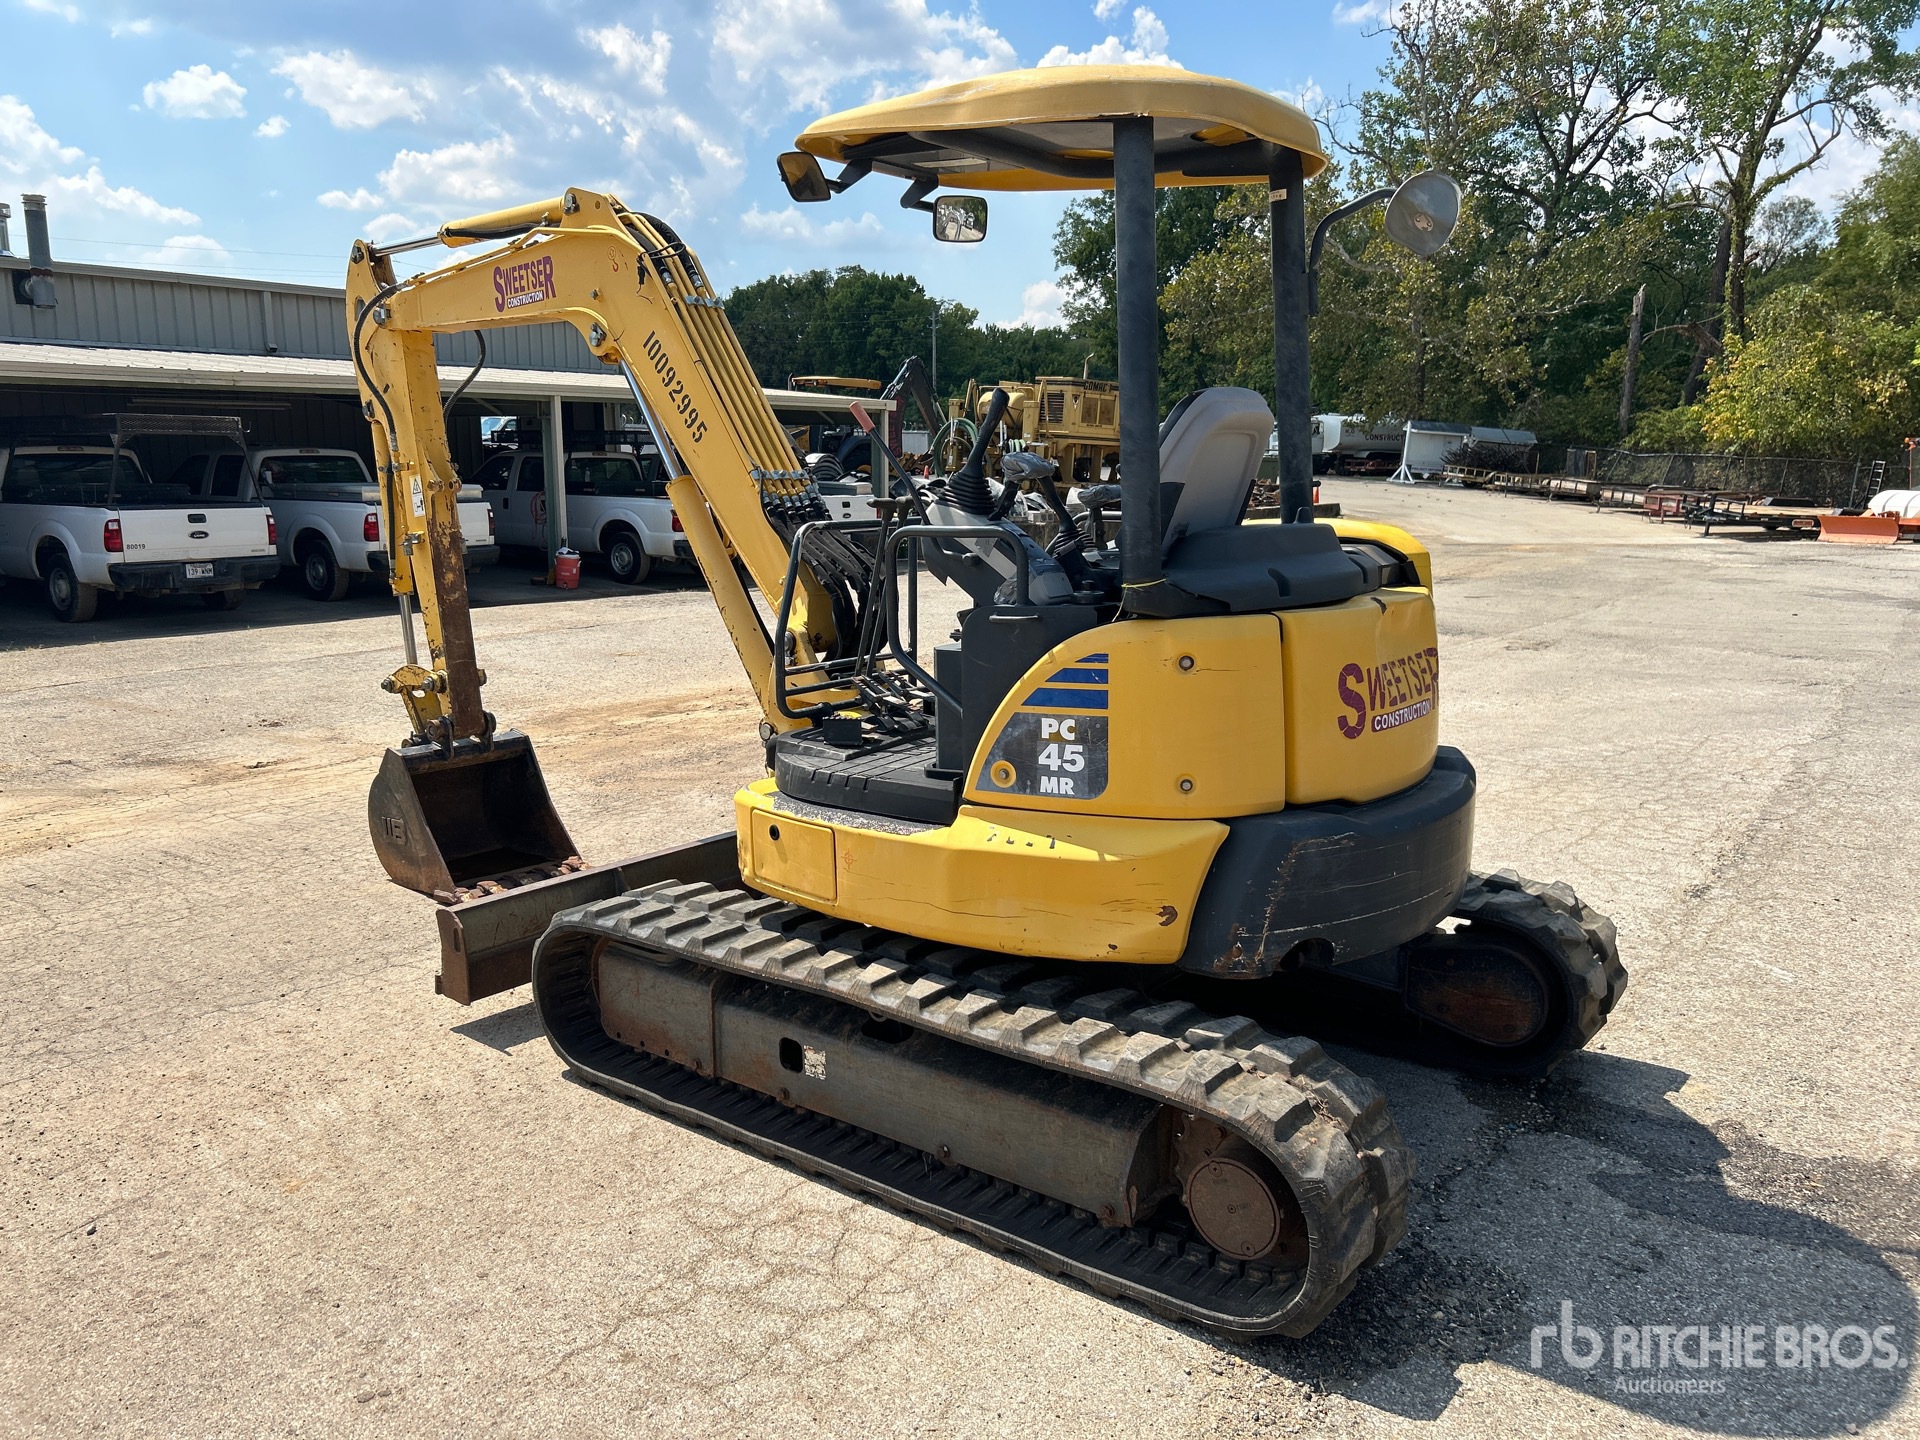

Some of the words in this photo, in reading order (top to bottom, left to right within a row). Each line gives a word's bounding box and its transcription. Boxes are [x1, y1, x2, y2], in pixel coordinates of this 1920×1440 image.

[493, 255, 557, 312] SWEETSER
[507, 290, 544, 309] CONSTRUCTION
[642, 330, 708, 443] 10092995
[1041, 717, 1076, 741] PC
[1373, 698, 1432, 731] CONSTRUCTION
[1038, 743, 1085, 773] 45
[1039, 775, 1075, 795] MR
